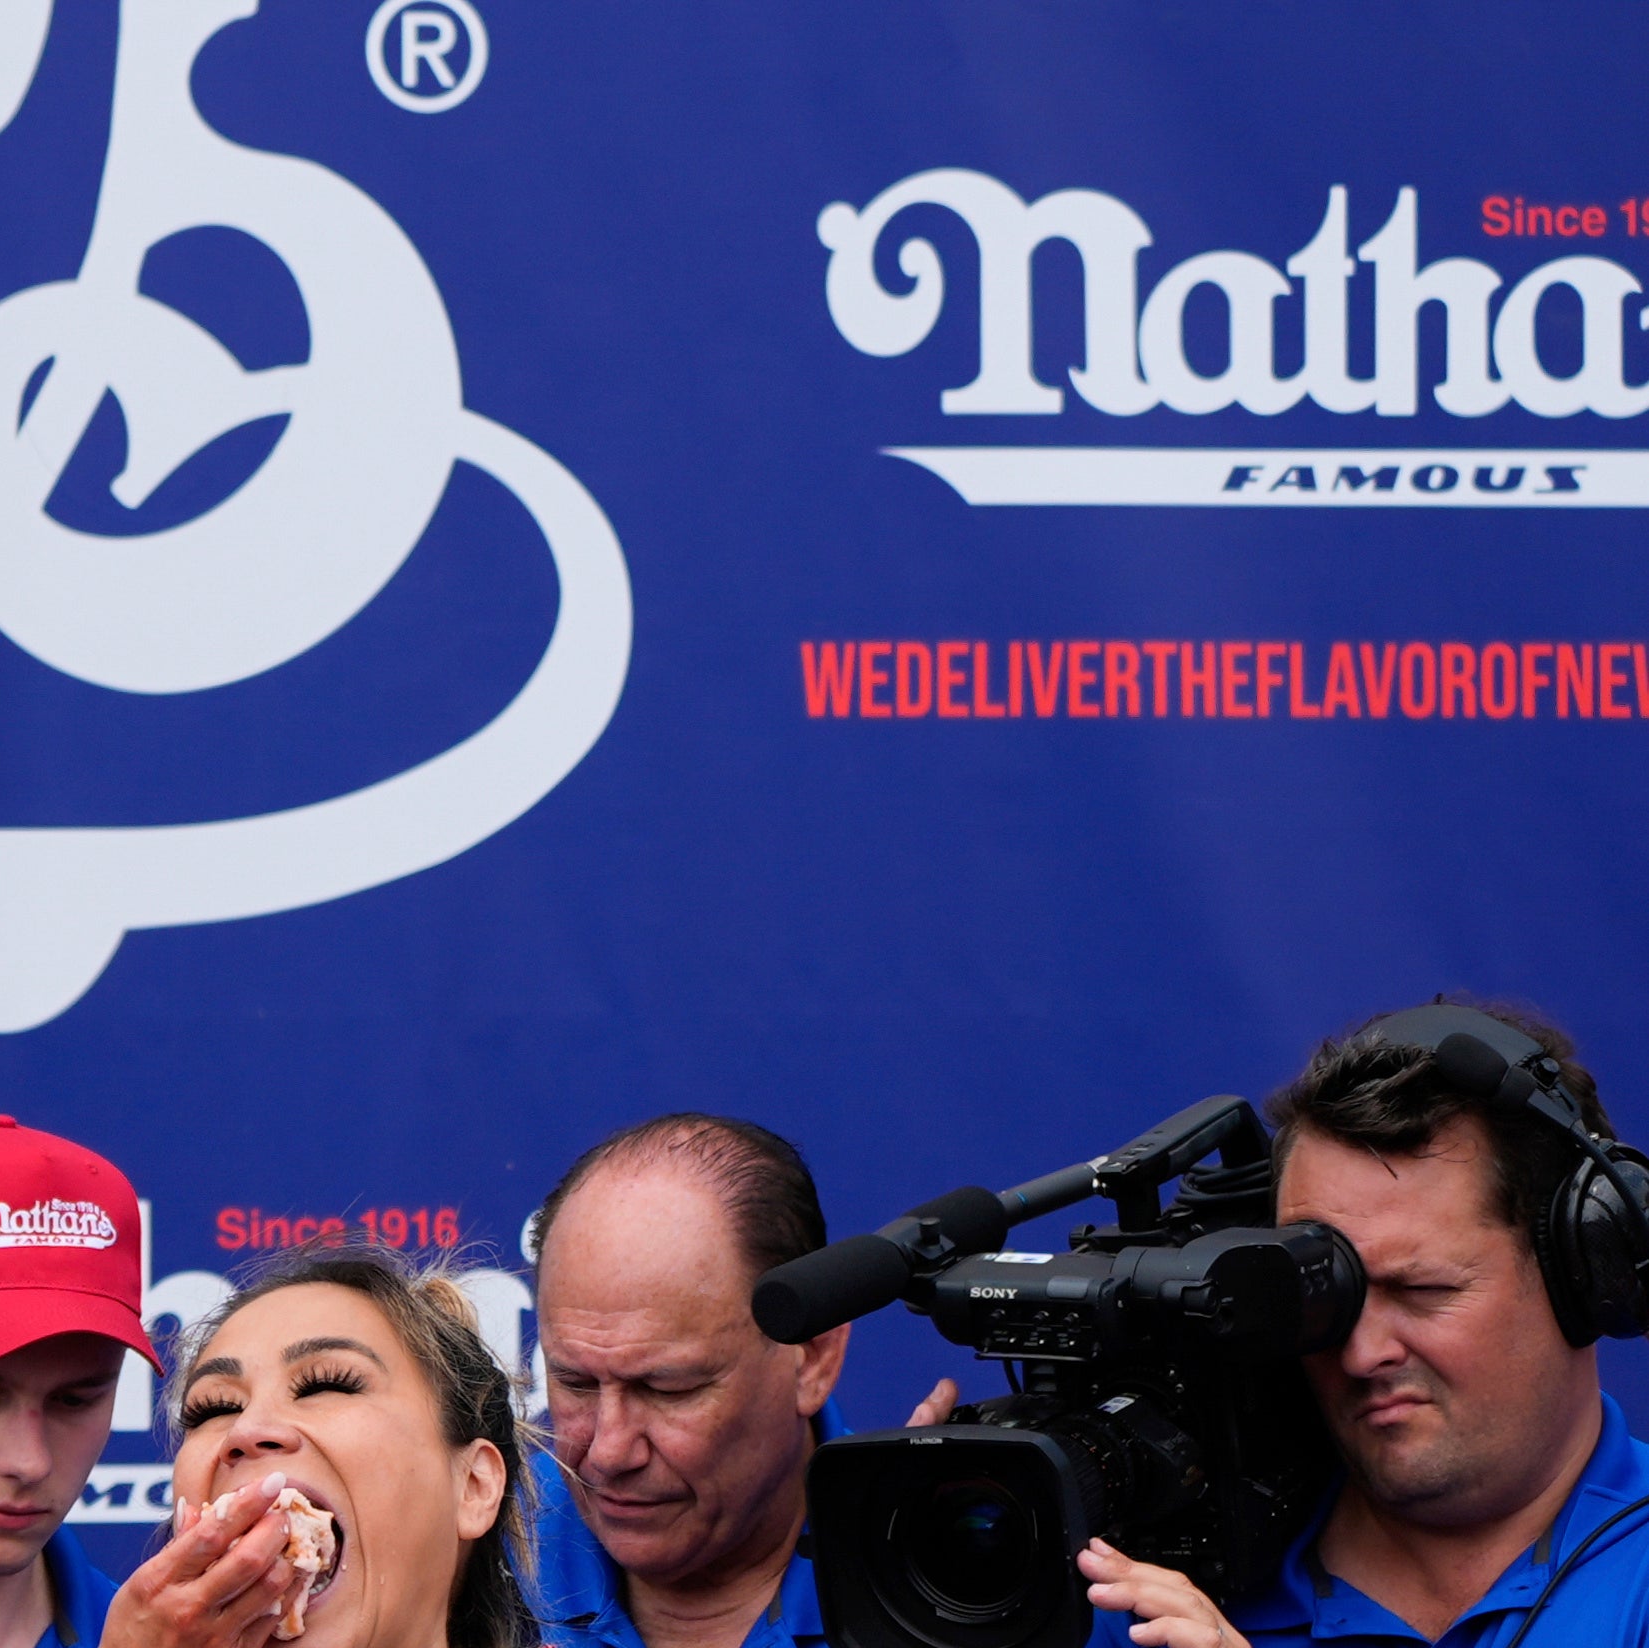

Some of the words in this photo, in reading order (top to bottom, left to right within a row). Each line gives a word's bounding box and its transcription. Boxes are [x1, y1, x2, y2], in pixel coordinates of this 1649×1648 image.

[1483, 199, 1607, 237] Since
[1222, 464, 1589, 493] FAMOUS
[216, 1207, 347, 1249] Since
[357, 1207, 460, 1249] 1916
[970, 1287, 1018, 1299] SONY
